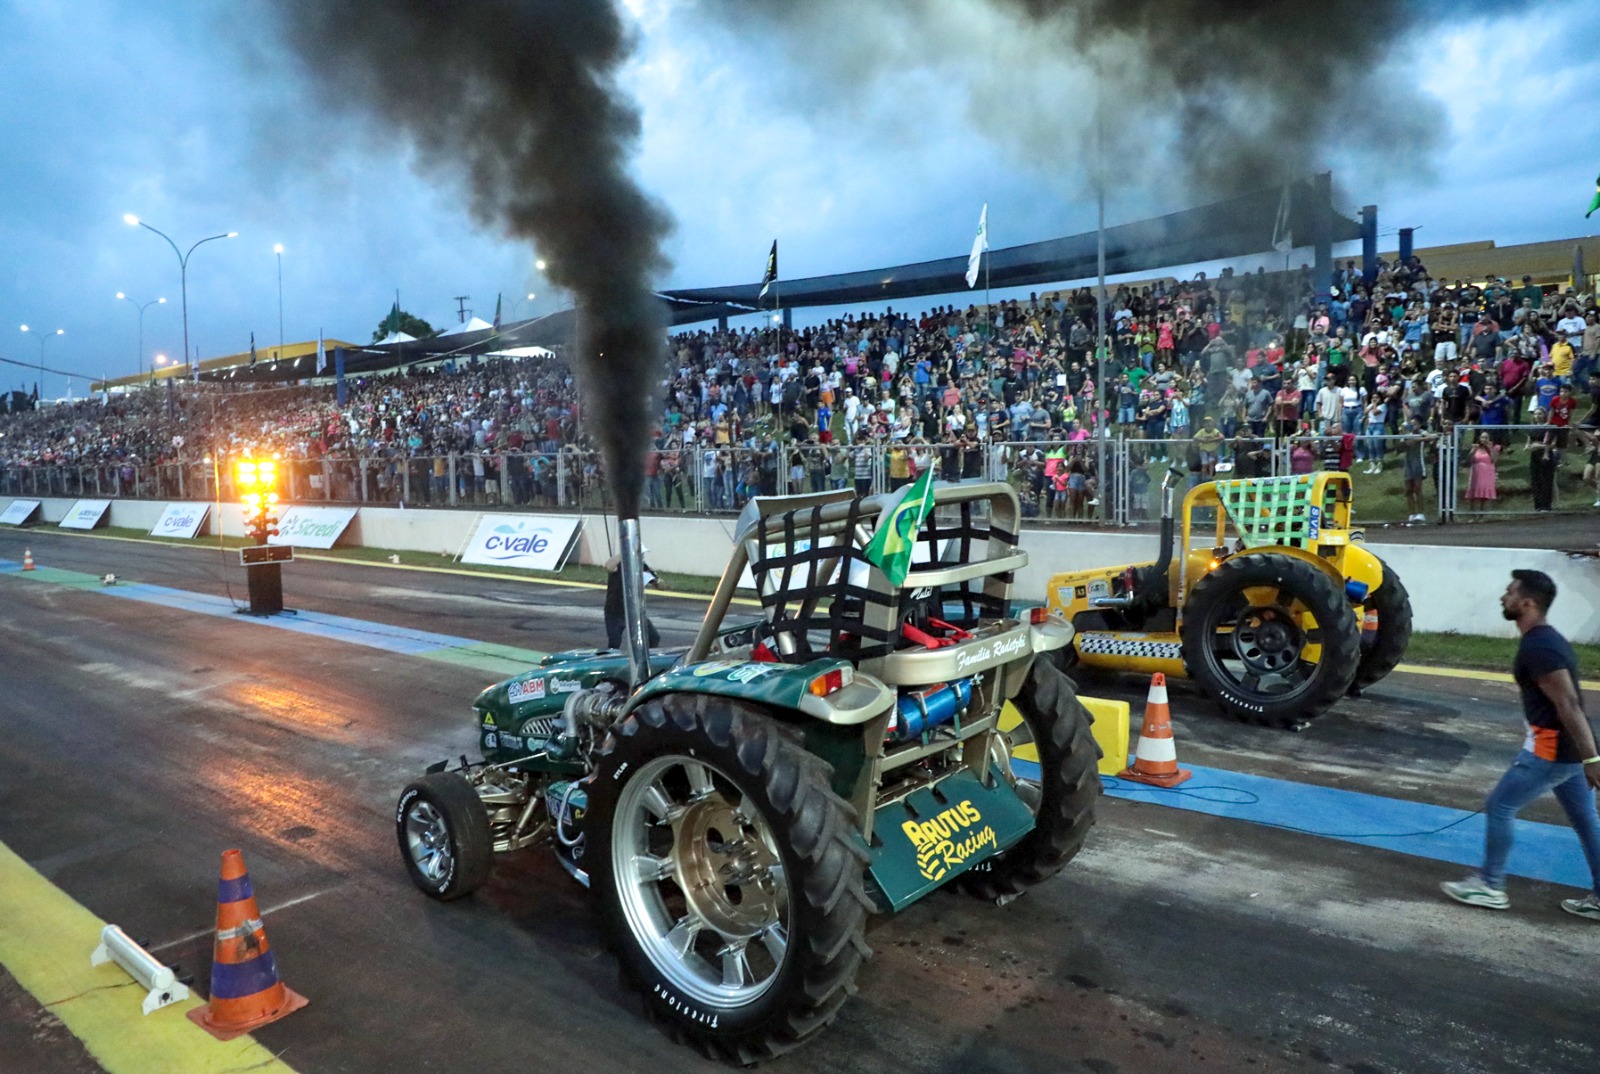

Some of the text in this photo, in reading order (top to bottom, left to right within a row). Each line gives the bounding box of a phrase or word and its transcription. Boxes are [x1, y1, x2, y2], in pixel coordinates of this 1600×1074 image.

[293, 518, 342, 538] Sicredi
[1309, 506, 1320, 540] SVM
[957, 647, 991, 671] Familia
[522, 680, 544, 695] ABM
[902, 800, 981, 848] BRUTUS
[935, 827, 997, 870] Racing
[654, 984, 718, 1028] Firestone
